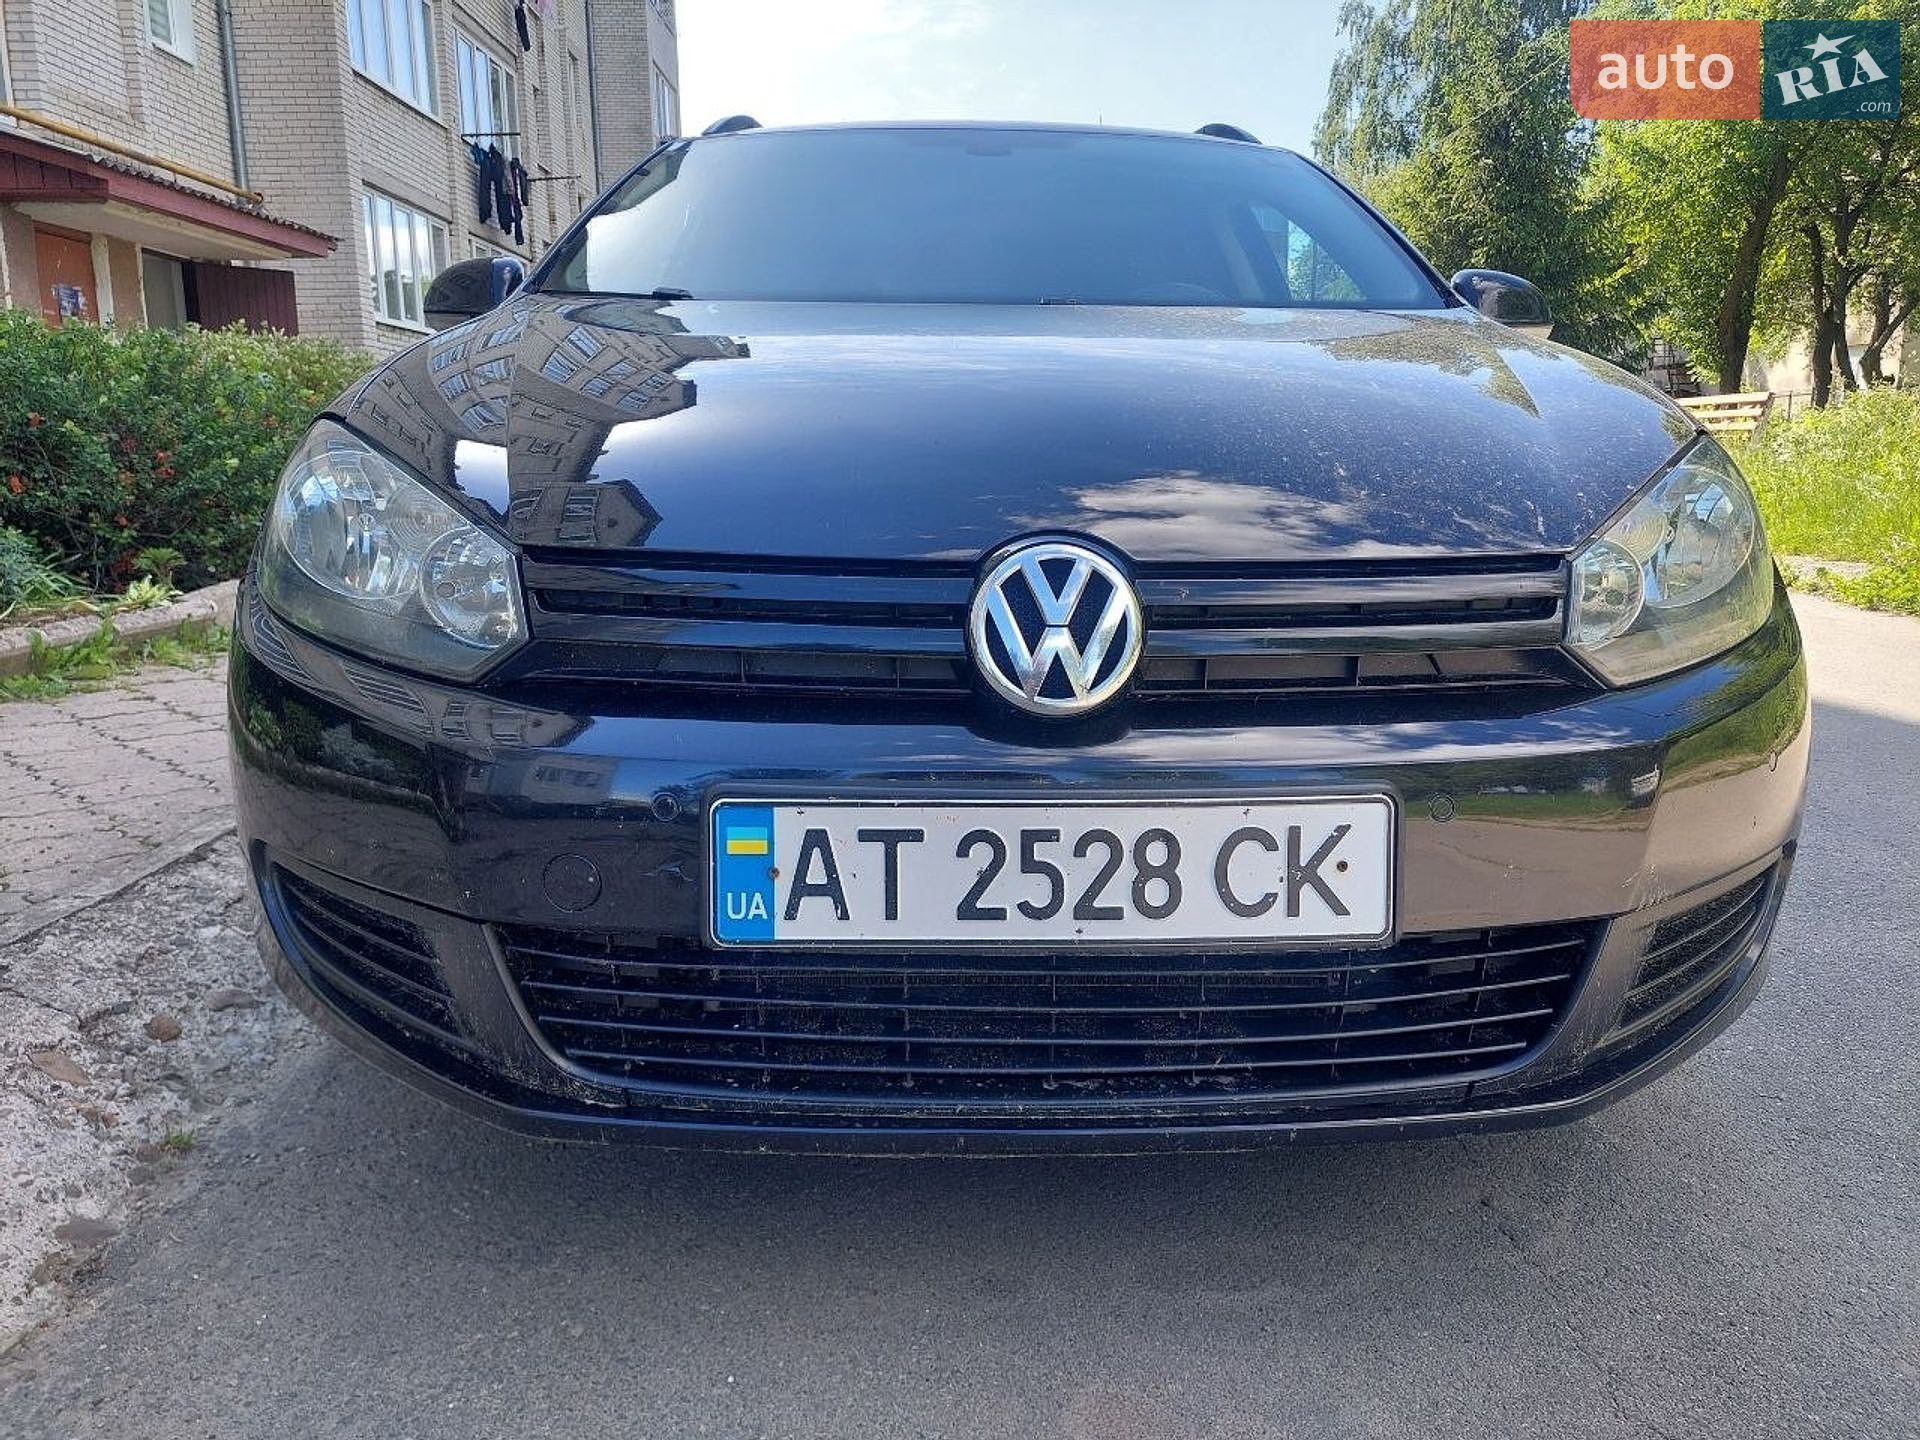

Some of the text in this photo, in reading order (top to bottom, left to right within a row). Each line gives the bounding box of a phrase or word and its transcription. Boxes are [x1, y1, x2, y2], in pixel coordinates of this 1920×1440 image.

[783, 824, 1352, 922] AT 2528 CK
[727, 892, 767, 920] UA
